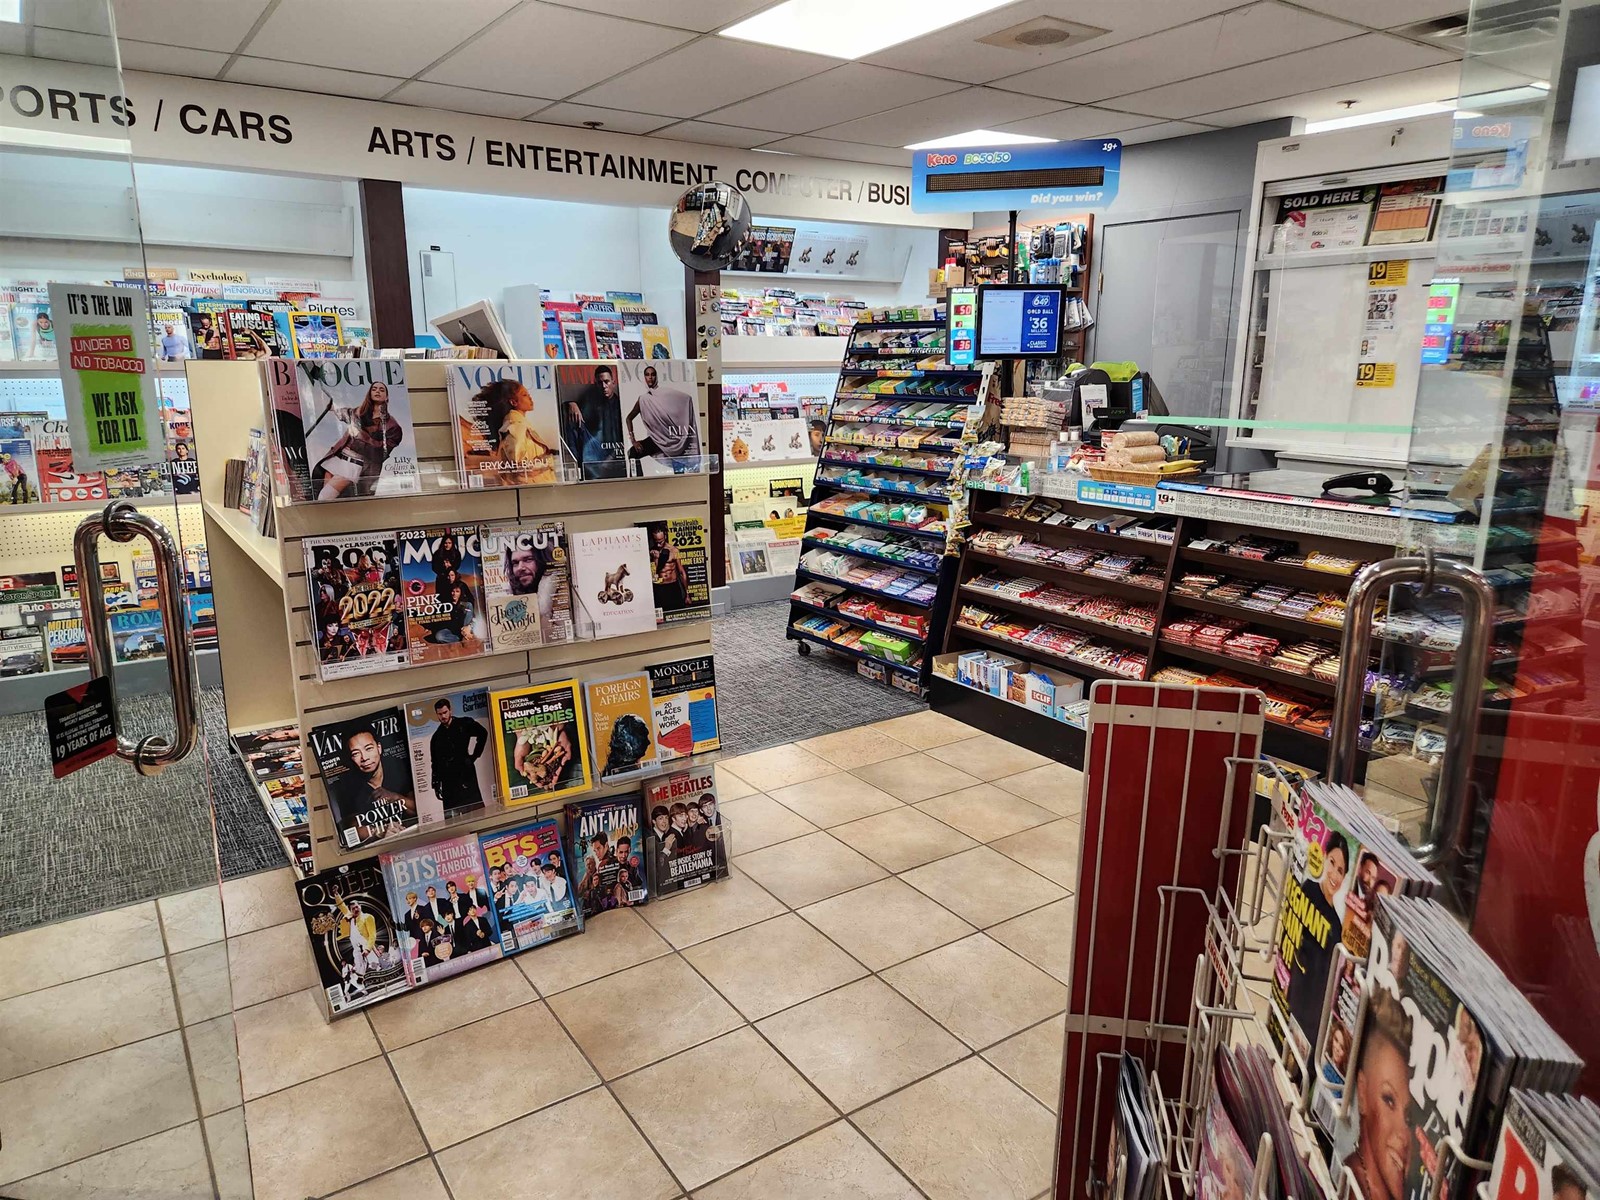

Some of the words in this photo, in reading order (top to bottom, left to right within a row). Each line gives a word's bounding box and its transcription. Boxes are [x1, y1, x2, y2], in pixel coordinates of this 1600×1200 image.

[179, 103, 293, 145] CARS
[1102, 142, 1118, 152] 19+
[367, 126, 456, 161] ARTS
[485, 139, 718, 186] ENTERTAINMENT
[927, 153, 957, 167] Keno
[735, 169, 852, 201] COMPUTER
[1030, 194, 1049, 204] Did
[1051, 194, 1073, 206] you
[1074, 191, 1103, 203] win?
[1283, 195, 1319, 209] SOLD
[1321, 189, 1361, 205] HERE
[189, 270, 243, 284] Psychology
[1369, 261, 1386, 279] 19
[168, 283, 219, 296] Menopause
[224, 287, 273, 295] MENOPAUSE
[67, 293, 89, 315] IT'S
[91, 294, 110, 316] THE
[112, 295, 133, 317] LAW
[308, 303, 355, 316] Pilates
[229, 312, 261, 322] EATING
[261, 313, 273, 322] for
[231, 320, 274, 331] MUSCLE
[74, 338, 113, 353] UNDER
[115, 337, 130, 351] 19
[73, 355, 91, 369] NO
[95, 357, 145, 373] TOBACCO
[1358, 364, 1374, 379] 19
[273, 360, 291, 386] B
[297, 360, 406, 388] VOGUE
[458, 365, 551, 391] VOGUE
[91, 392, 112, 418] WE
[115, 391, 139, 416] ASK
[97, 419, 122, 445] FOR
[122, 417, 142, 443] I.D.
[668, 425, 696, 436] IMAN
[394, 456, 412, 464] Lily
[479, 458, 520, 471] ERYKAH
[521, 457, 549, 469] BADU
[400, 530, 426, 540] 2023
[668, 525, 703, 533] TRAINING
[675, 530, 697, 538] GUIDE
[344, 540, 377, 548] CLASSIC
[482, 531, 560, 555] UNCUT
[581, 533, 642, 548] LAPHAM'S
[671, 536, 702, 547] 2023
[338, 587, 396, 624] 2022
[406, 593, 441, 608] PINK
[407, 602, 454, 618] FLOYD
[653, 660, 710, 678] MONOCLE
[595, 679, 642, 696] FOREIGN
[509, 697, 530, 705] NATIONAL
[509, 700, 535, 709] GEOGRAPHIC
[599, 690, 641, 706] AFFAIRS
[1035, 692, 1052, 704] CLIF
[503, 707, 542, 720] Nature's
[542, 702, 563, 714] Best
[655, 706, 682, 717] PLACES
[504, 708, 574, 731] REMEDIES
[658, 719, 680, 729] WORK
[56, 744, 66, 758] 19
[67, 735, 88, 753] YEARS
[89, 730, 98, 743] OF
[99, 724, 113, 739] AGE
[321, 756, 341, 766] POWER
[322, 762, 338, 771] SHIFT
[669, 774, 714, 799] BEATLES
[688, 790, 704, 799] YEARS
[371, 796, 390, 809] THE
[355, 798, 408, 828] POWER
[593, 807, 613, 815] ULTIMATE
[366, 812, 405, 836] FIFTY
[579, 807, 638, 838] ANT-MAN
[484, 834, 539, 868] BTS
[668, 859, 678, 868] THE
[677, 855, 692, 866] INSIDE
[691, 851, 706, 861] STORY
[706, 848, 713, 857] OF
[393, 854, 438, 888] BTS
[433, 841, 477, 863] ULTIMATE
[437, 855, 479, 876] FANBOOK
[670, 856, 714, 878] BEATLEMANIA
